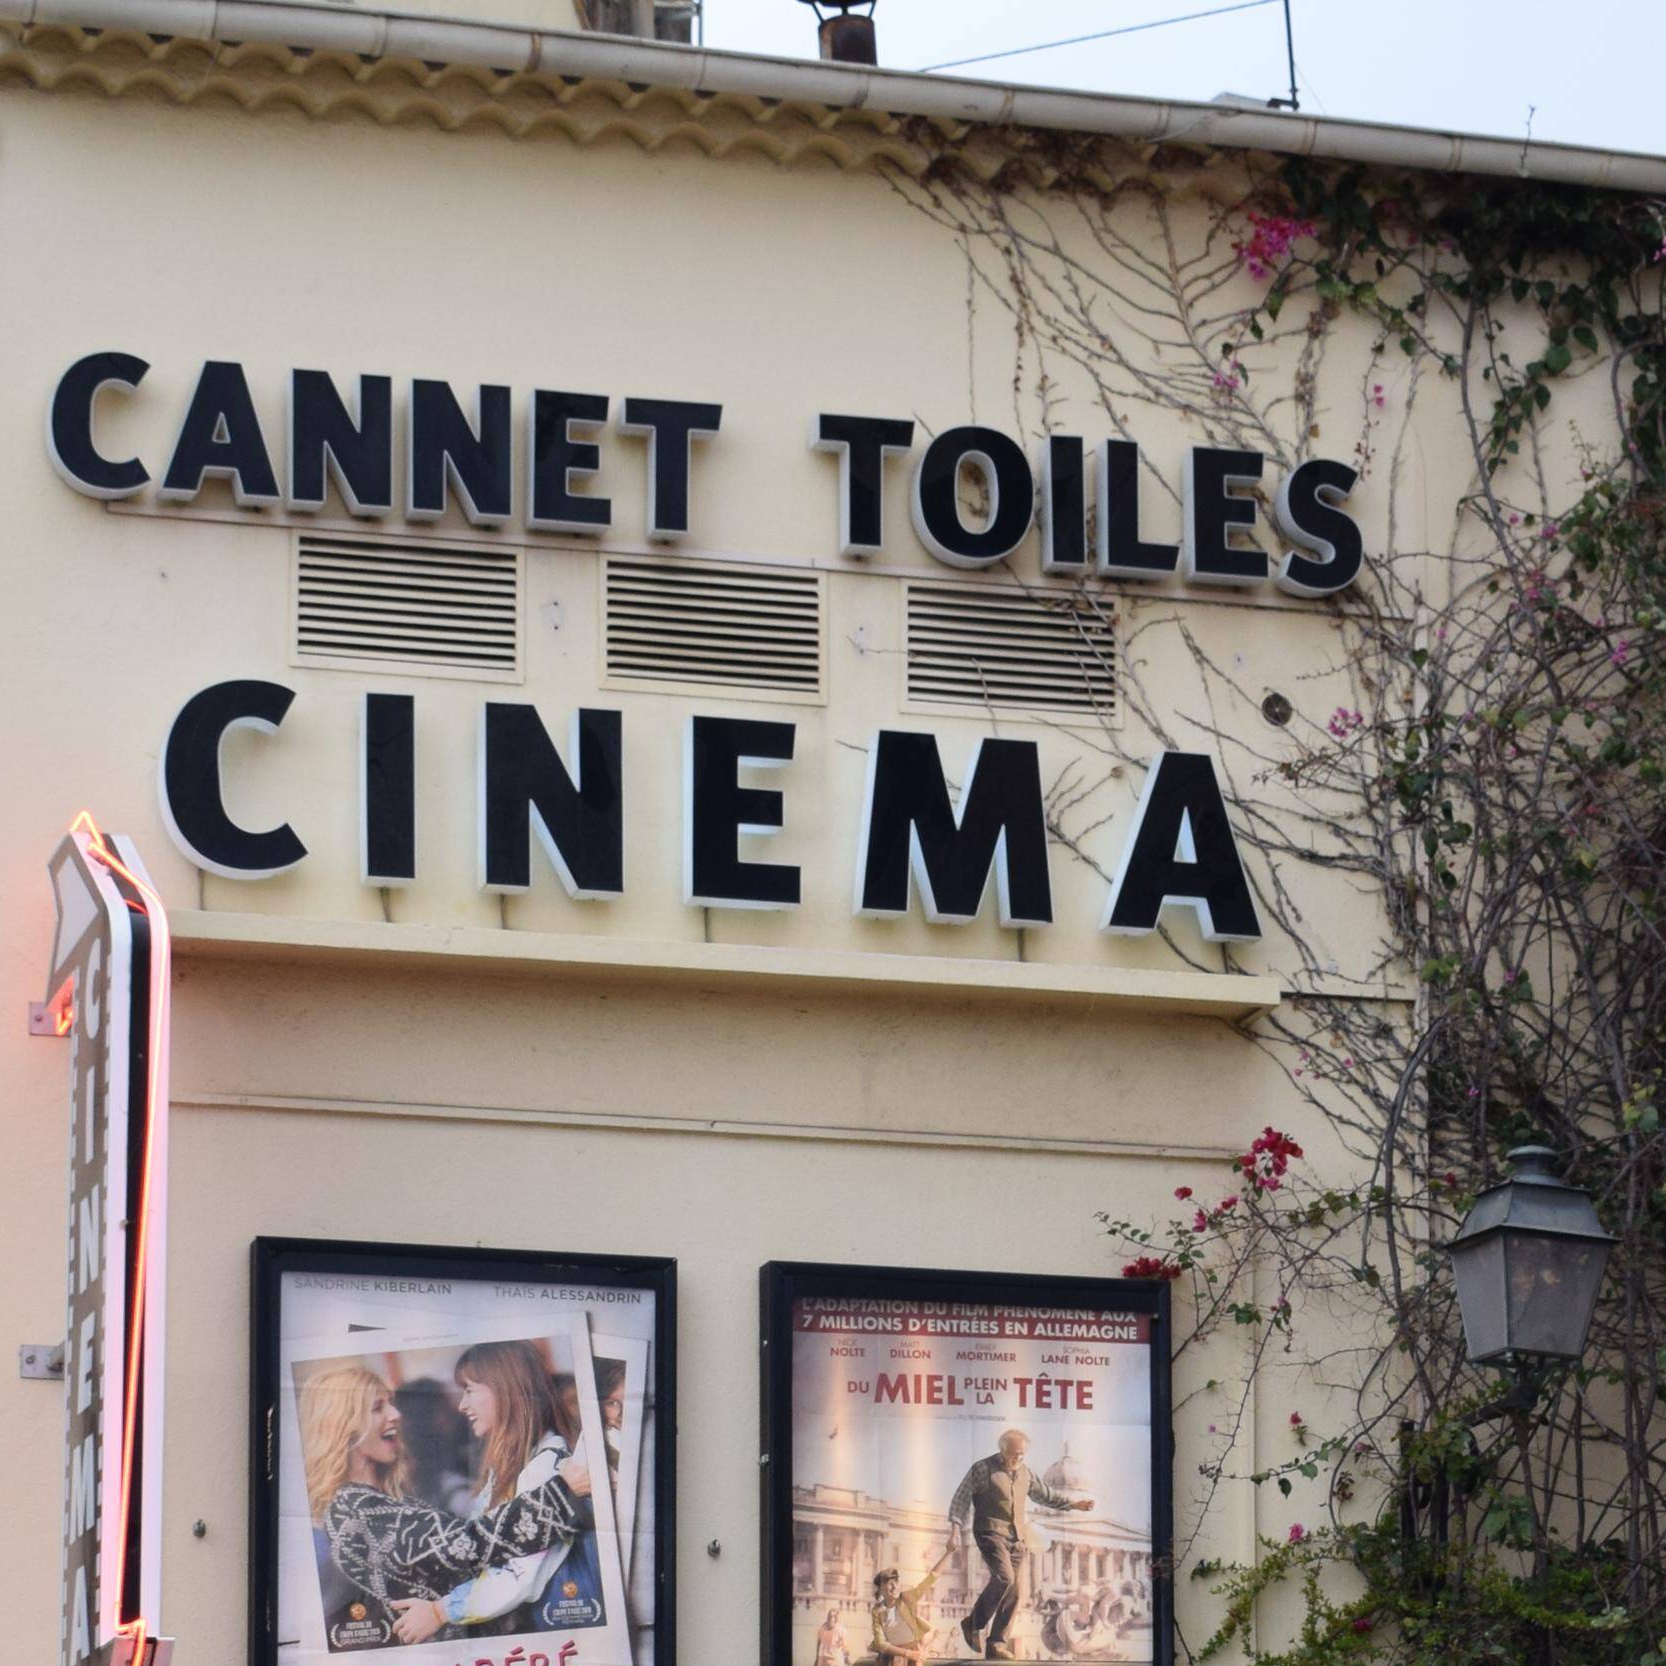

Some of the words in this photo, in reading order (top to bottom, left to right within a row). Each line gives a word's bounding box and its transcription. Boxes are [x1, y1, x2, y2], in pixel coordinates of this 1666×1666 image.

[48, 350, 723, 546] CANNET
[811, 411, 1364, 600] TOILES
[160, 678, 1262, 947] CINEMA
[294, 1276, 370, 1292] SANDRINE
[373, 1279, 452, 1295] KIBERLAIN
[540, 1288, 642, 1304] ALESSANDRIN
[923, 1302, 947, 1315] DU
[952, 1303, 985, 1317] FILM
[802, 1315, 811, 1327] 7
[819, 1317, 903, 1331] MILLIONS
[908, 1316, 999, 1335] D'ENTRÉES
[1005, 1322, 1029, 1336] EN
[1033, 1323, 1138, 1340] ALLEMAGNE
[830, 1347, 866, 1357] NOLTE
[890, 1348, 931, 1359] DILLON
[956, 1351, 1017, 1363] MORTIMER
[1041, 1354, 1070, 1364] LANE
[1075, 1356, 1110, 1367] NOLTE
[847, 1381, 869, 1393] DU
[873, 1373, 965, 1405] MIEL
[964, 1377, 1007, 1391] PLEIN
[1013, 1372, 1094, 1410] TÊTE
[976, 1393, 994, 1405] LA
